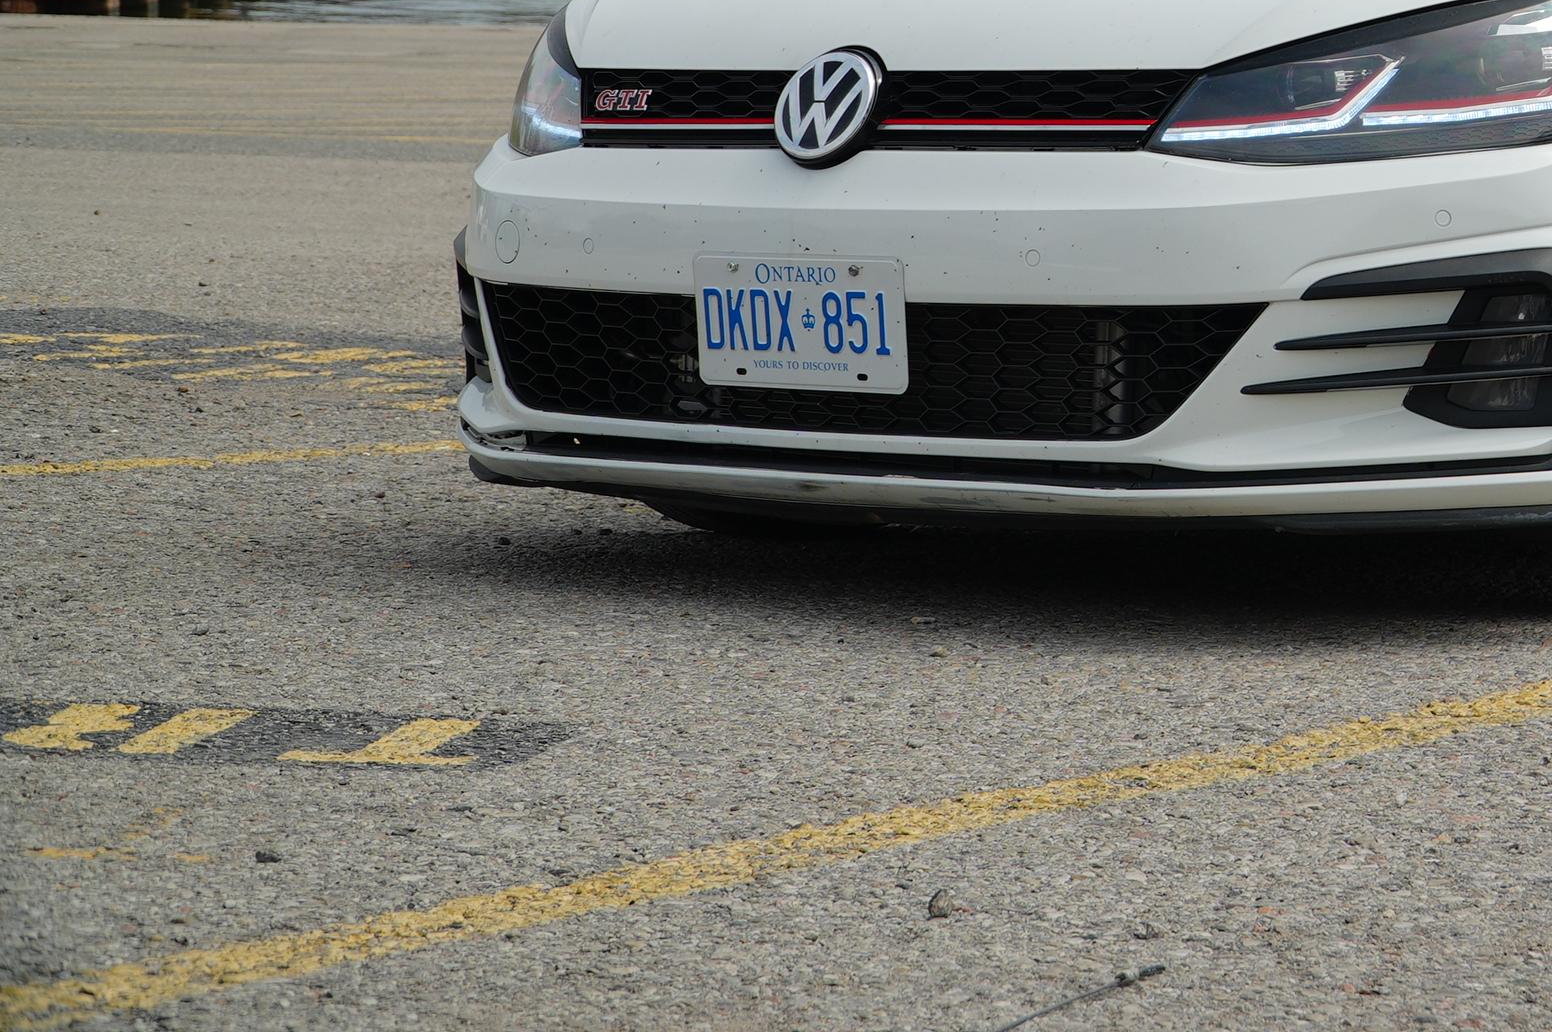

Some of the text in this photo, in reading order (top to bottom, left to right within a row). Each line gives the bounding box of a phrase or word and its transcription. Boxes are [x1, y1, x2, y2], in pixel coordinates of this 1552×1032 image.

[595, 89, 653, 111] GTI
[755, 263, 836, 285] ONTARIO
[703, 288, 891, 356] DKDX 851
[753, 359, 849, 373] YOURS TO DISCOVER
